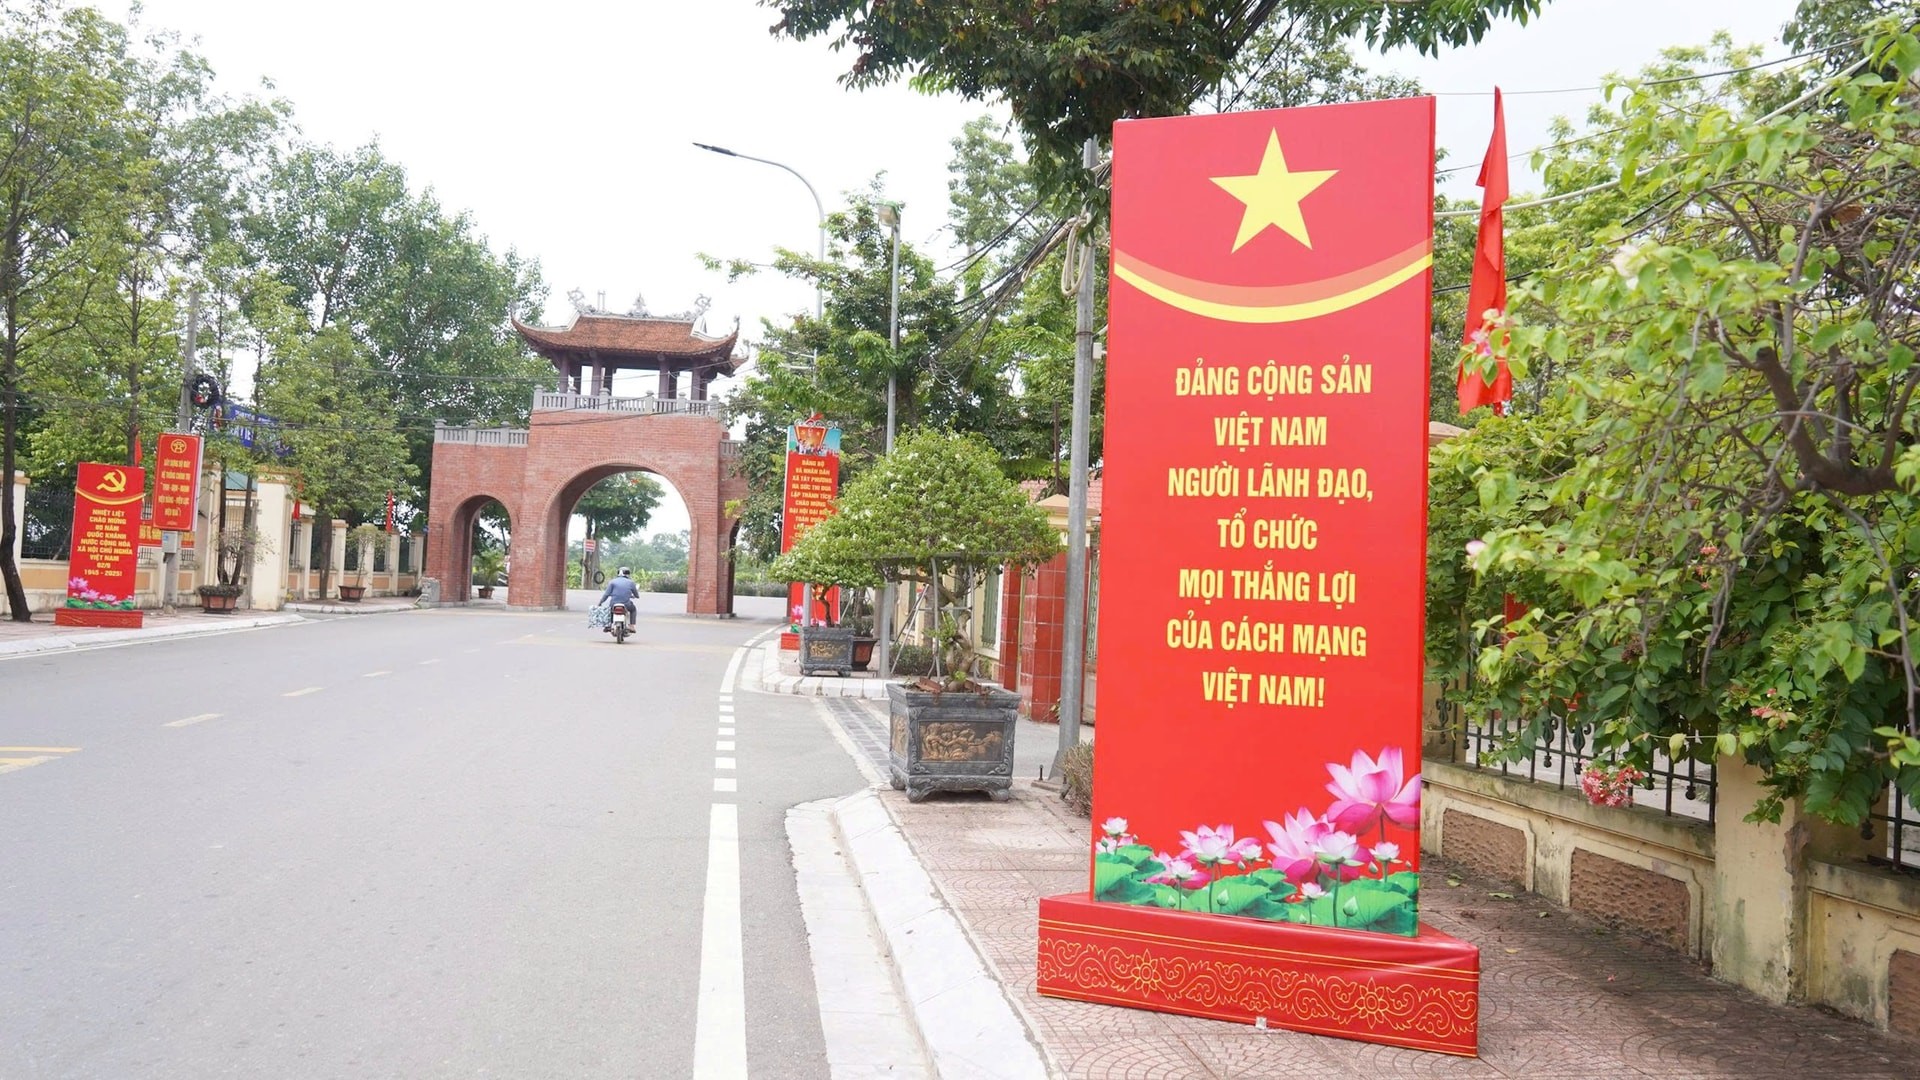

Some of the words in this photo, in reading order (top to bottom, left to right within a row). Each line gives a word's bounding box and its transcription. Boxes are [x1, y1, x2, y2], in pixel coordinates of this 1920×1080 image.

[1175, 357, 1239, 395] ĐẢNG
[1247, 360, 1312, 401] CỘNG
[1321, 354, 1372, 394] SẢN
[1214, 411, 1264, 452] VIỆT
[1270, 417, 1327, 445] NAM
[1168, 461, 1239, 496] NGƯỜI
[1247, 462, 1309, 498] LÃNH
[1318, 468, 1373, 504] ĐẠO,
[100, 539, 117, 547] CỘNG
[1218, 508, 1247, 547] TỔ
[1253, 514, 1317, 549] CHỨC
[1179, 569, 1223, 605] MỌI
[1231, 560, 1310, 601] THẮNG
[1318, 570, 1355, 609] LỢI
[1167, 610, 1213, 649] CỦA
[1221, 616, 1284, 653] CÁCH
[1293, 624, 1366, 662] MẠNG
[1202, 667, 1252, 708] VIỆT
[1259, 675, 1324, 707] NAM!
